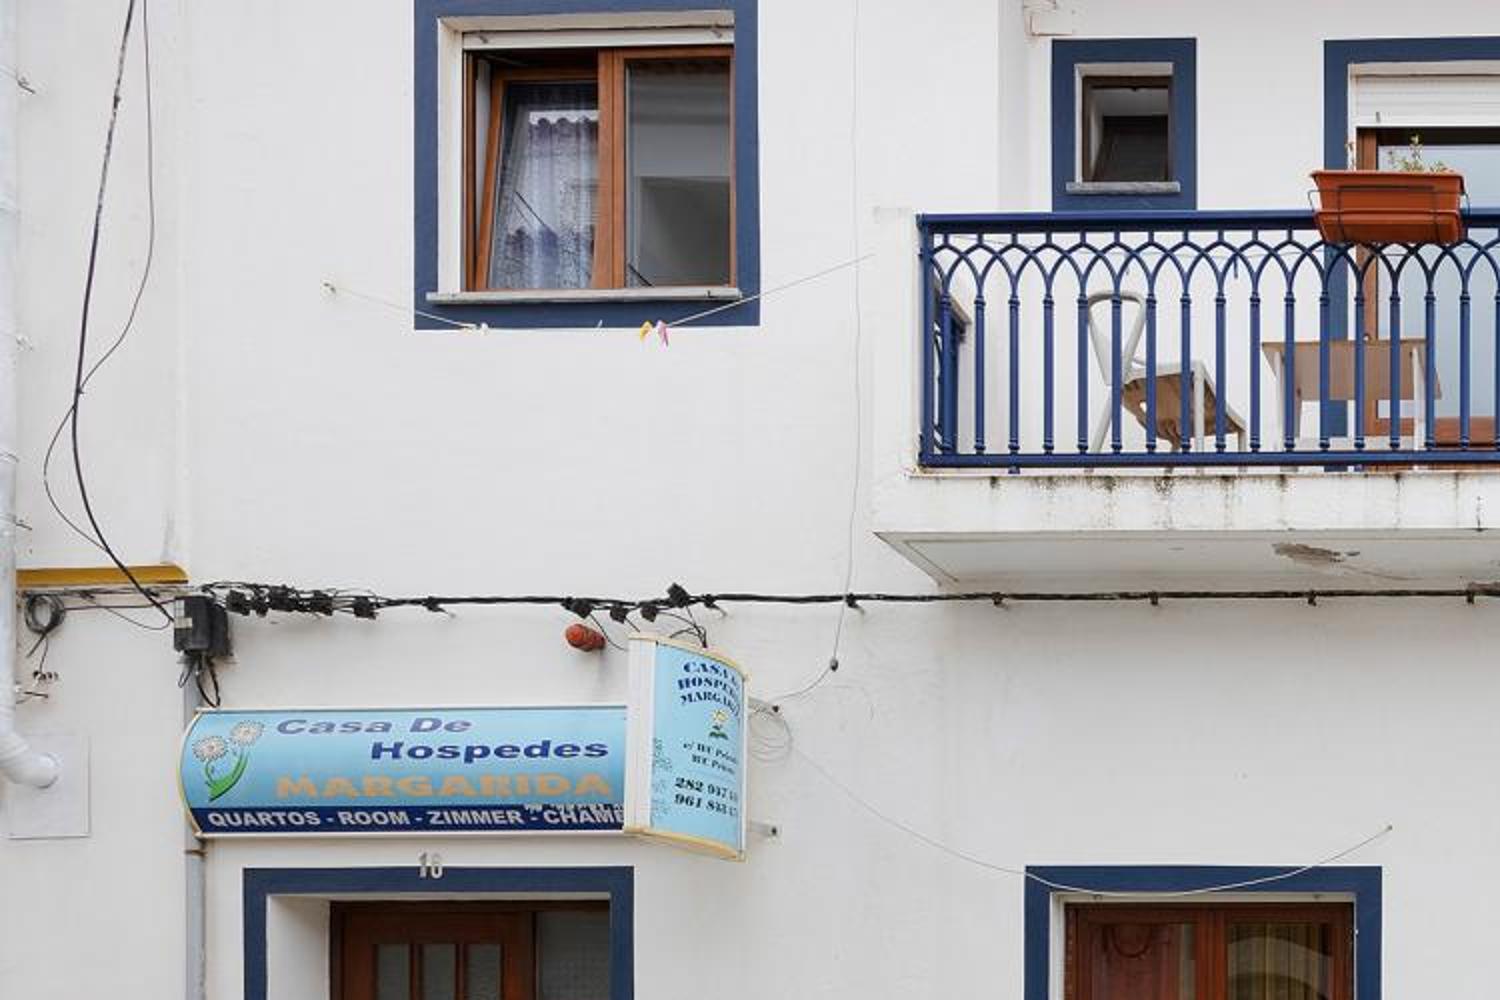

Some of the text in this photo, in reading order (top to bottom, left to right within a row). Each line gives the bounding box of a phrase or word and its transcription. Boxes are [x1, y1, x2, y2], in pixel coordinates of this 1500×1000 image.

[277, 717, 473, 735] Casa De
[371, 740, 609, 764] Hospedes
[276, 772, 610, 799] MARGARIDA
[674, 777, 704, 793] 282
[208, 811, 321, 827] QUARTOS
[337, 810, 411, 826] ROOM
[426, 810, 525, 825] ZIMMER
